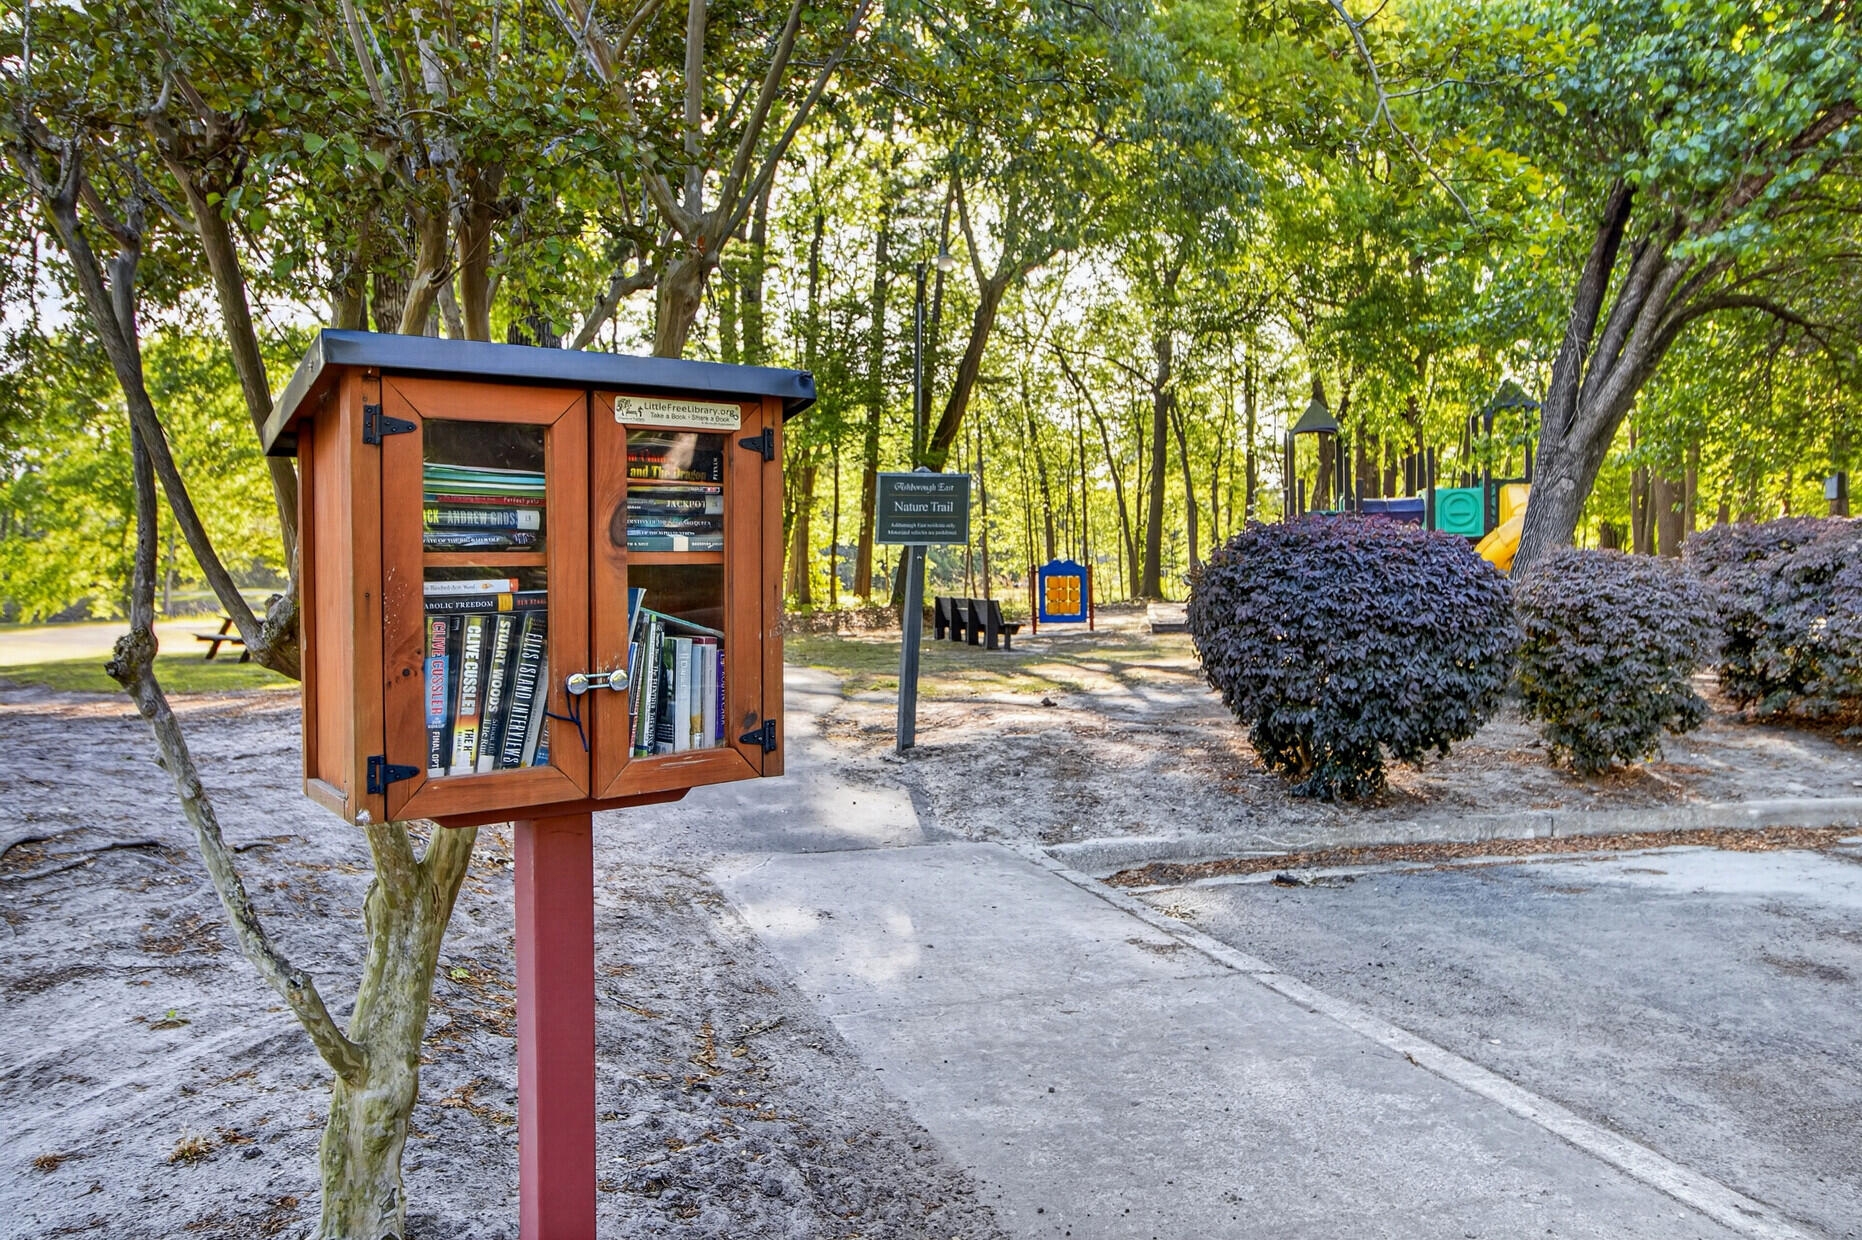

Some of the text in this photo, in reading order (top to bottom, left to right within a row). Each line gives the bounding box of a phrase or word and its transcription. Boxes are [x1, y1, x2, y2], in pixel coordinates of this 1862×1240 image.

[644, 401, 735, 417] LittleFreeLibrary.org
[650, 411, 664, 419] Take
[671, 412, 686, 420] Book
[630, 465, 649, 477] and
[651, 465, 671, 478] The
[938, 482, 954, 492] East
[447, 509, 488, 525] ANDREW
[490, 511, 518, 526] GROS
[894, 501, 954, 512] Nature Trail
[432, 621, 446, 658] CLIVE
[521, 632, 543, 660] ELLIS
[460, 625, 482, 716] CLIVE CUSSLER
[488, 620, 511, 713] STUART WOODS
[431, 660, 445, 715] CUSSLER
[514, 663, 538, 700] ISLAND
[431, 731, 440, 753] FINAL
[464, 728, 475, 744] THE
[502, 702, 530, 764] INTERVIEWS
